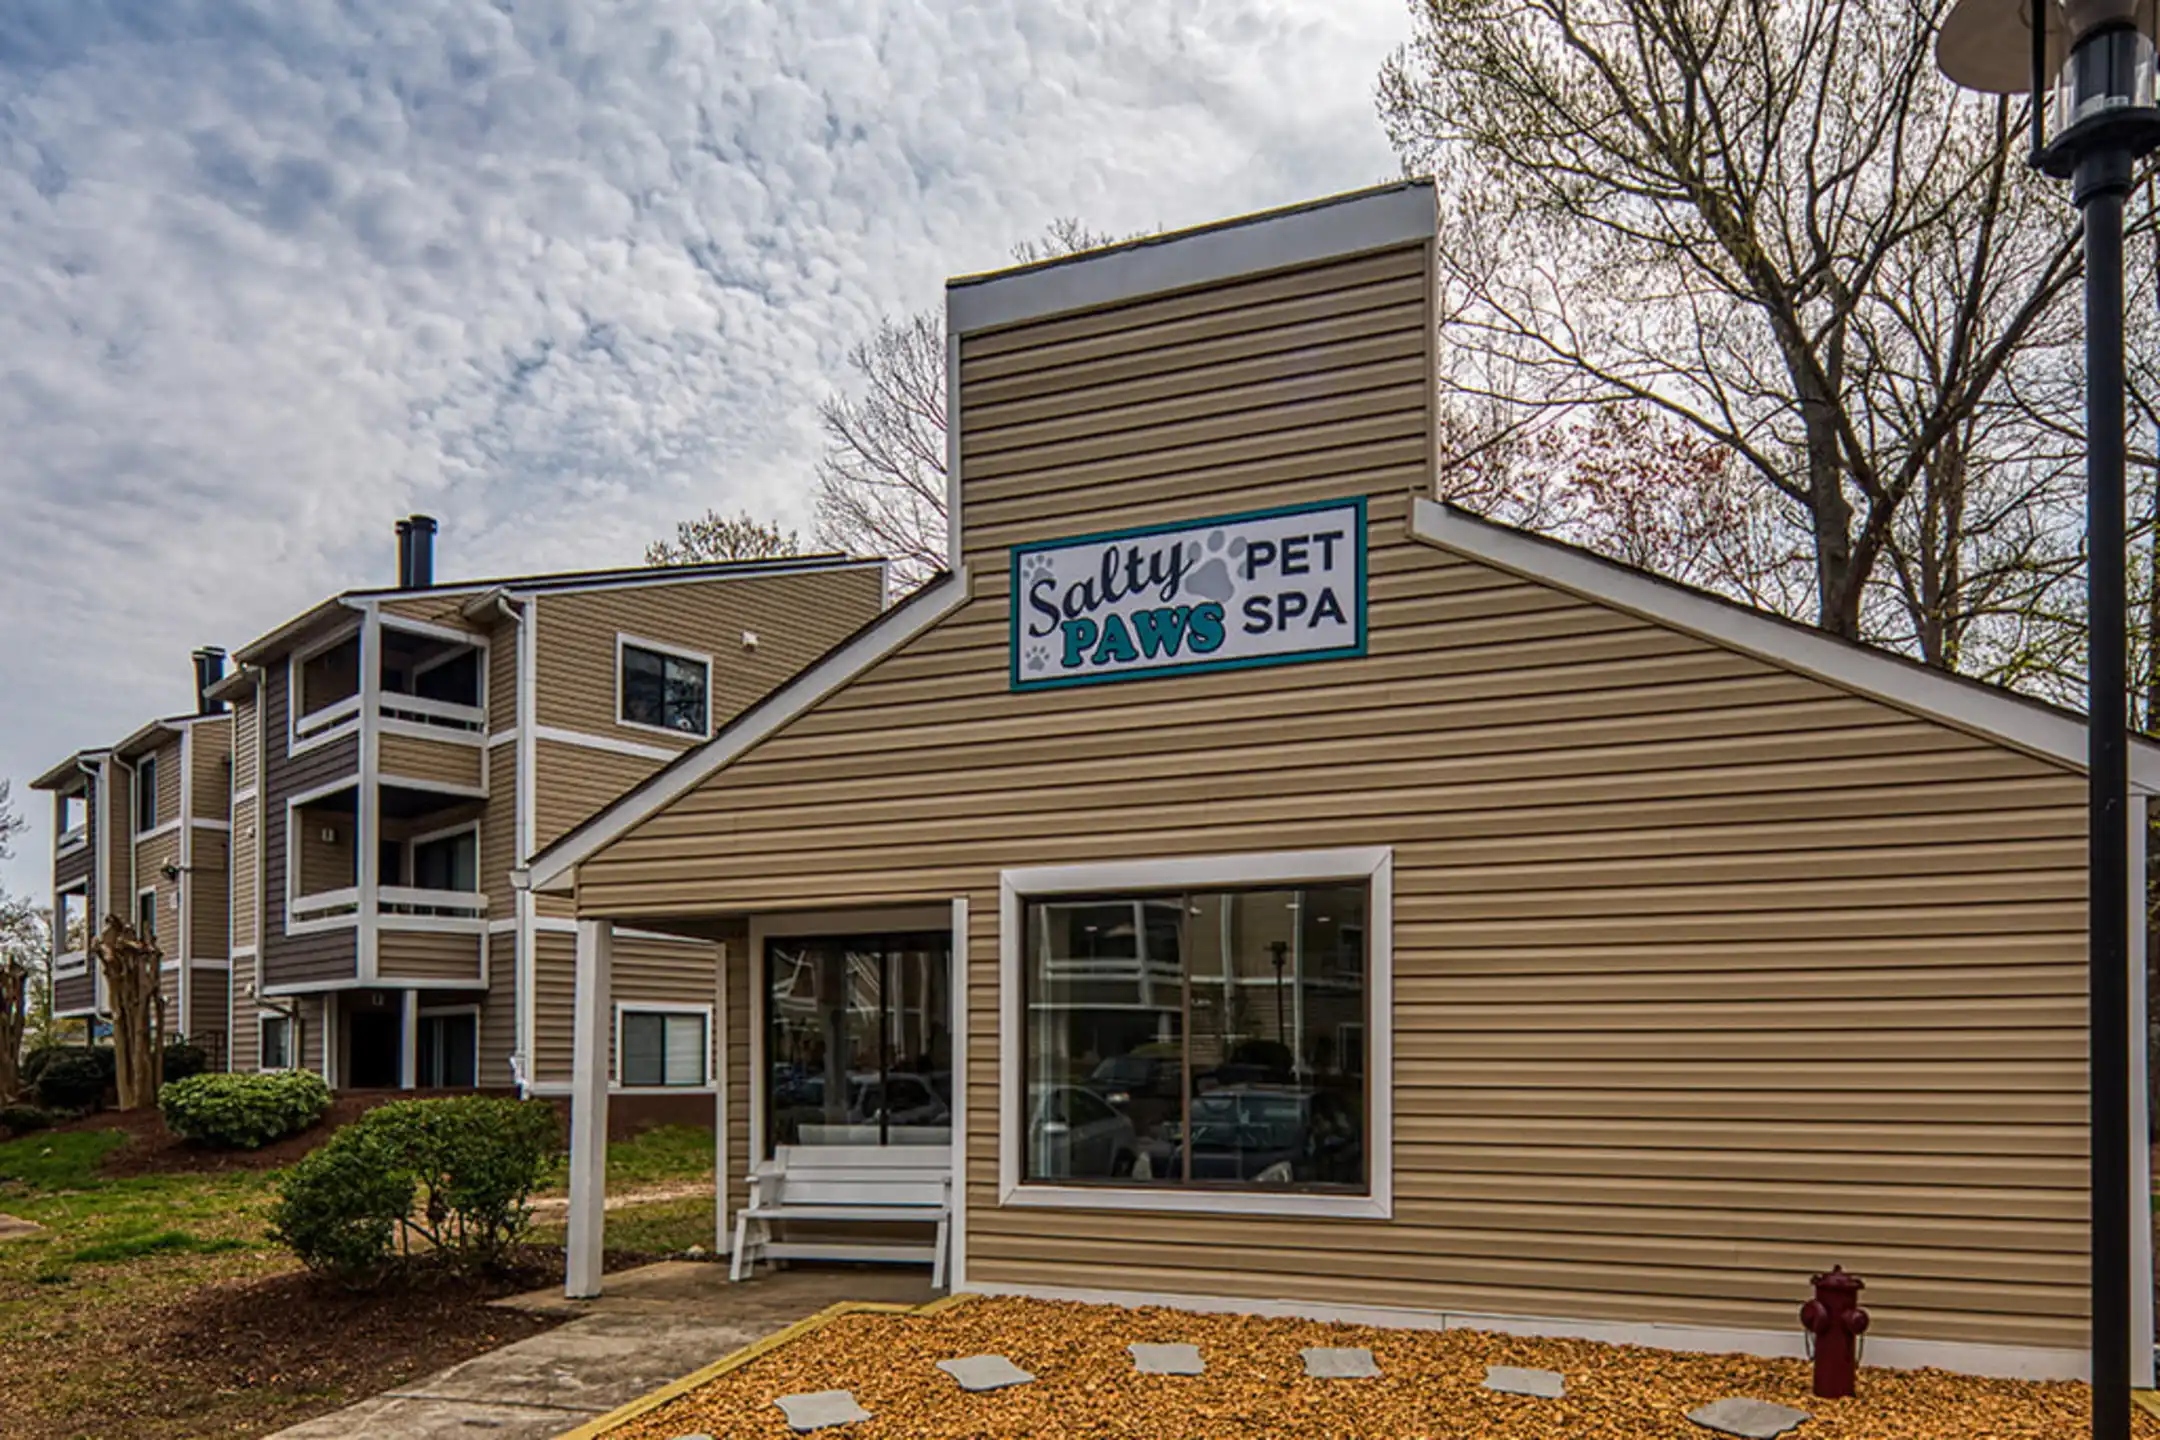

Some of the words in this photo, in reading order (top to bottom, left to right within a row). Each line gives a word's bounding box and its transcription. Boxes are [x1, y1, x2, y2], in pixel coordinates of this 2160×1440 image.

[1246, 530, 1344, 582] PET
[1028, 541, 1194, 638] Salty
[1242, 587, 1347, 634] SPA
[1061, 602, 1226, 669] PAWS
